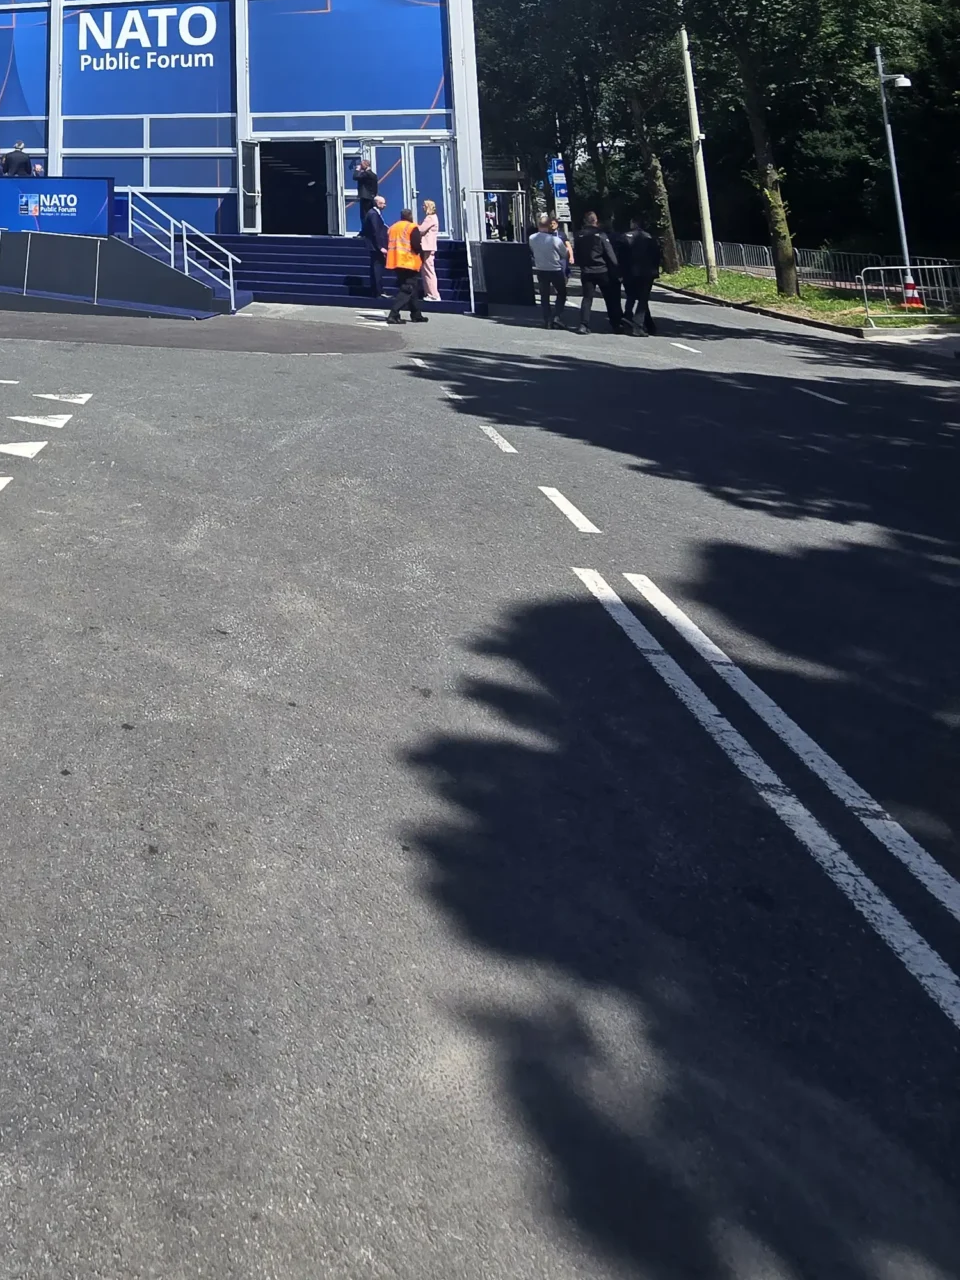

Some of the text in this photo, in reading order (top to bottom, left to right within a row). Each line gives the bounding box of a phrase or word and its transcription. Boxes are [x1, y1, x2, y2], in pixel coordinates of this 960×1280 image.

[79, 5, 217, 51] NATO
[80, 51, 214, 71] Public Forum
[40, 194, 77, 206] NATO
